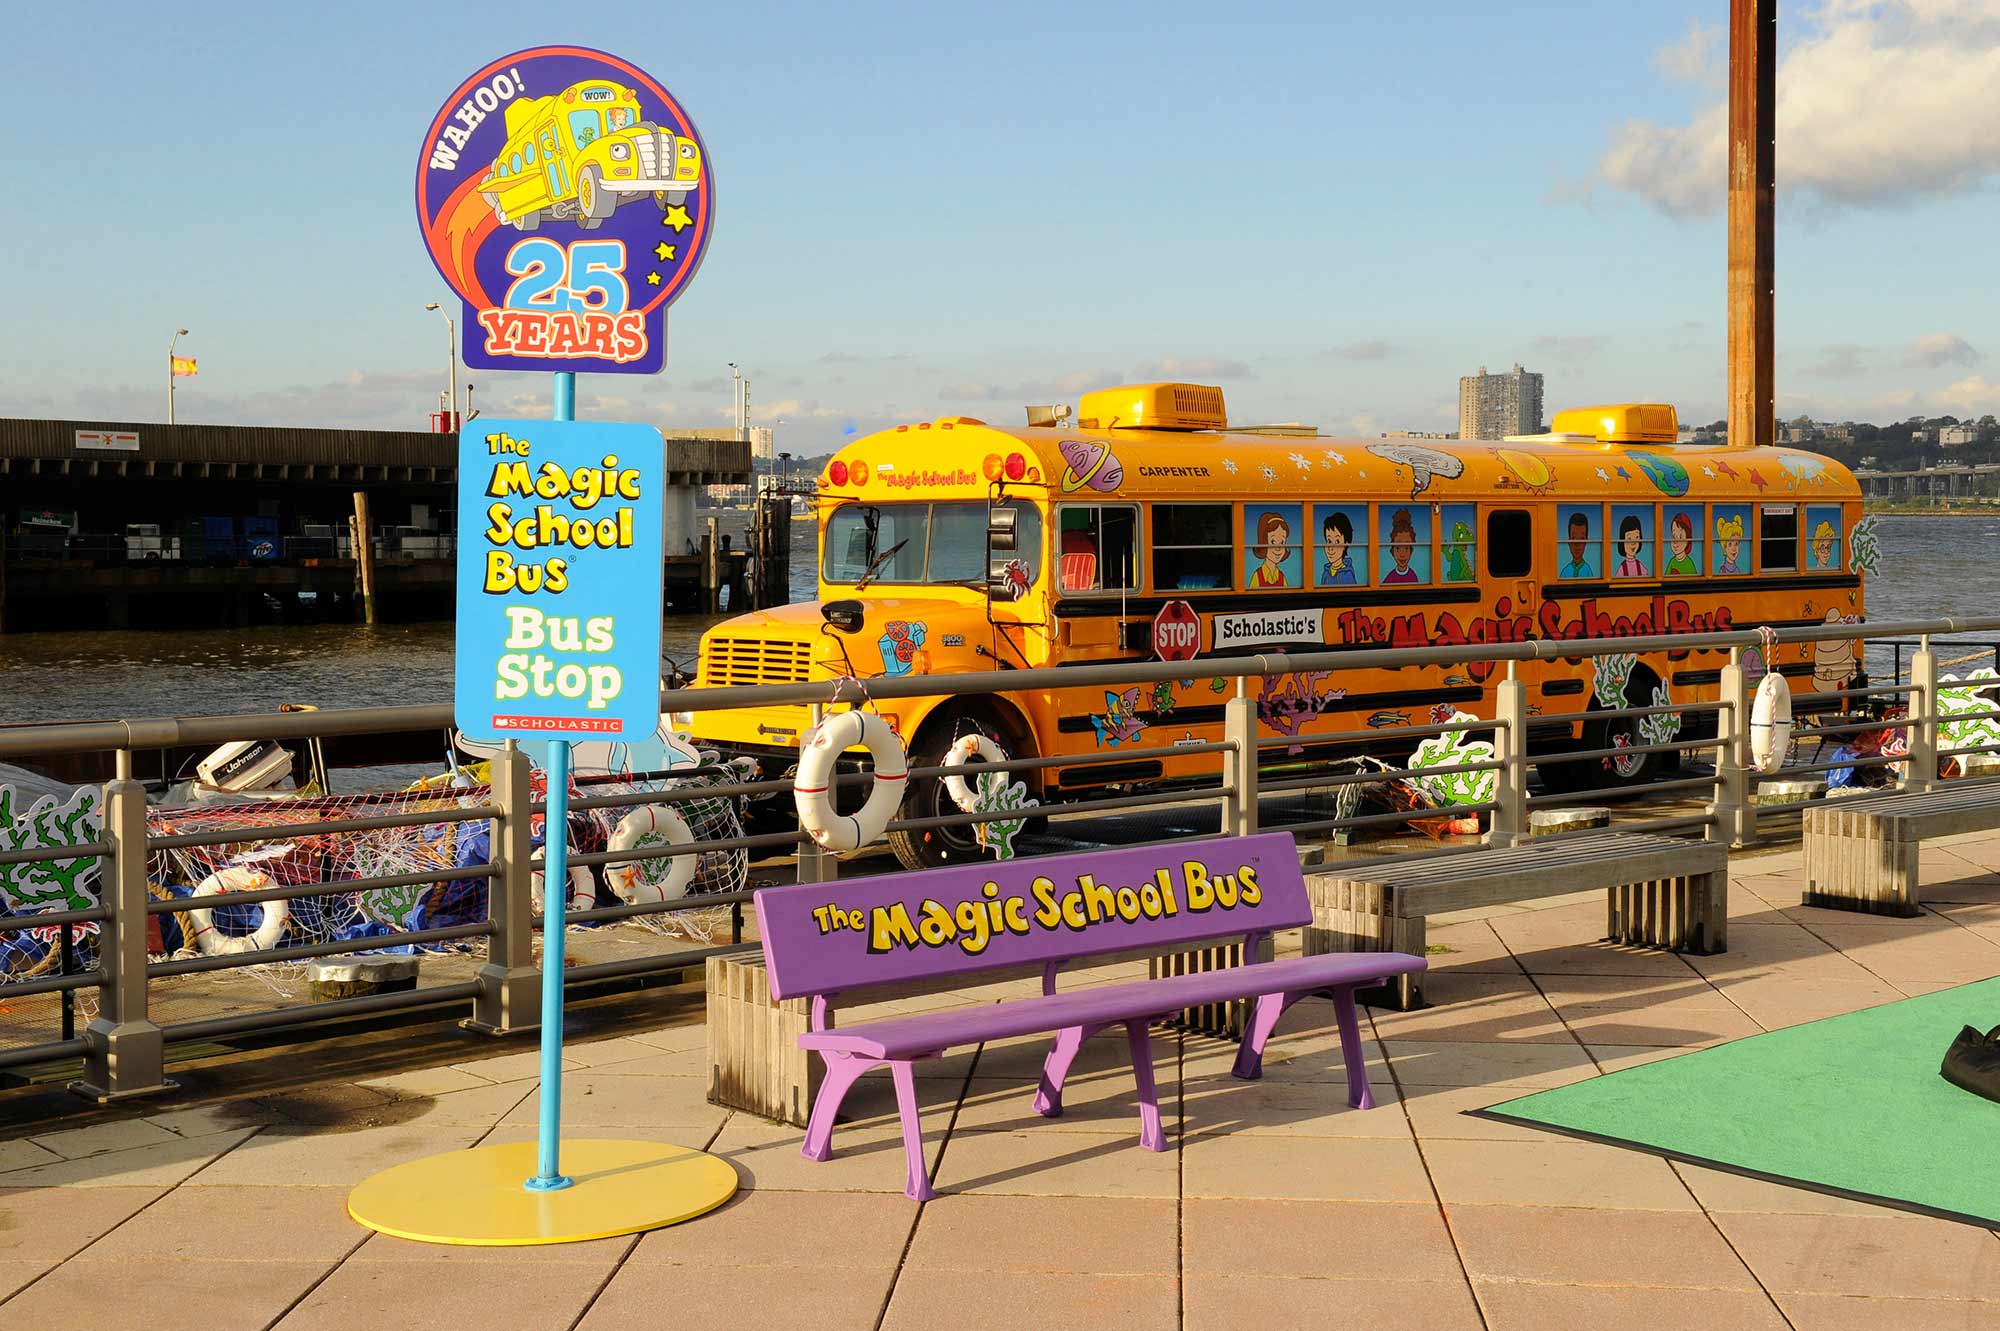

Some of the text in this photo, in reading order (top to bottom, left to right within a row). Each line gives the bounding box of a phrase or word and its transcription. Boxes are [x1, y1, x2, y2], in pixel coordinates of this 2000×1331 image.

[584, 91, 611, 100] WOW!
[430, 67, 526, 172] WAHOO!
[504, 237, 630, 316] 25
[477, 308, 648, 364] YEARS
[485, 432, 531, 457] The
[485, 455, 641, 509] Magic
[887, 470, 921, 490] Magic
[922, 470, 956, 486] School
[957, 469, 977, 485] Bus
[1139, 466, 1210, 477] CARPENTER
[484, 502, 634, 550] School
[483, 550, 568, 594] Bus
[504, 605, 615, 652] Bus
[1158, 622, 1197, 648] STOP
[1223, 616, 1316, 640] Scholastic's
[1338, 596, 1732, 683] The Magic School Bus
[495, 654, 624, 709] Stop
[508, 717, 621, 731] SCHOLASTIC
[226, 744, 264, 774] Johnson
[813, 902, 865, 935] The
[866, 880, 1030, 955] Magic
[1034, 867, 1178, 931] School
[1183, 860, 1263, 912] Bus
